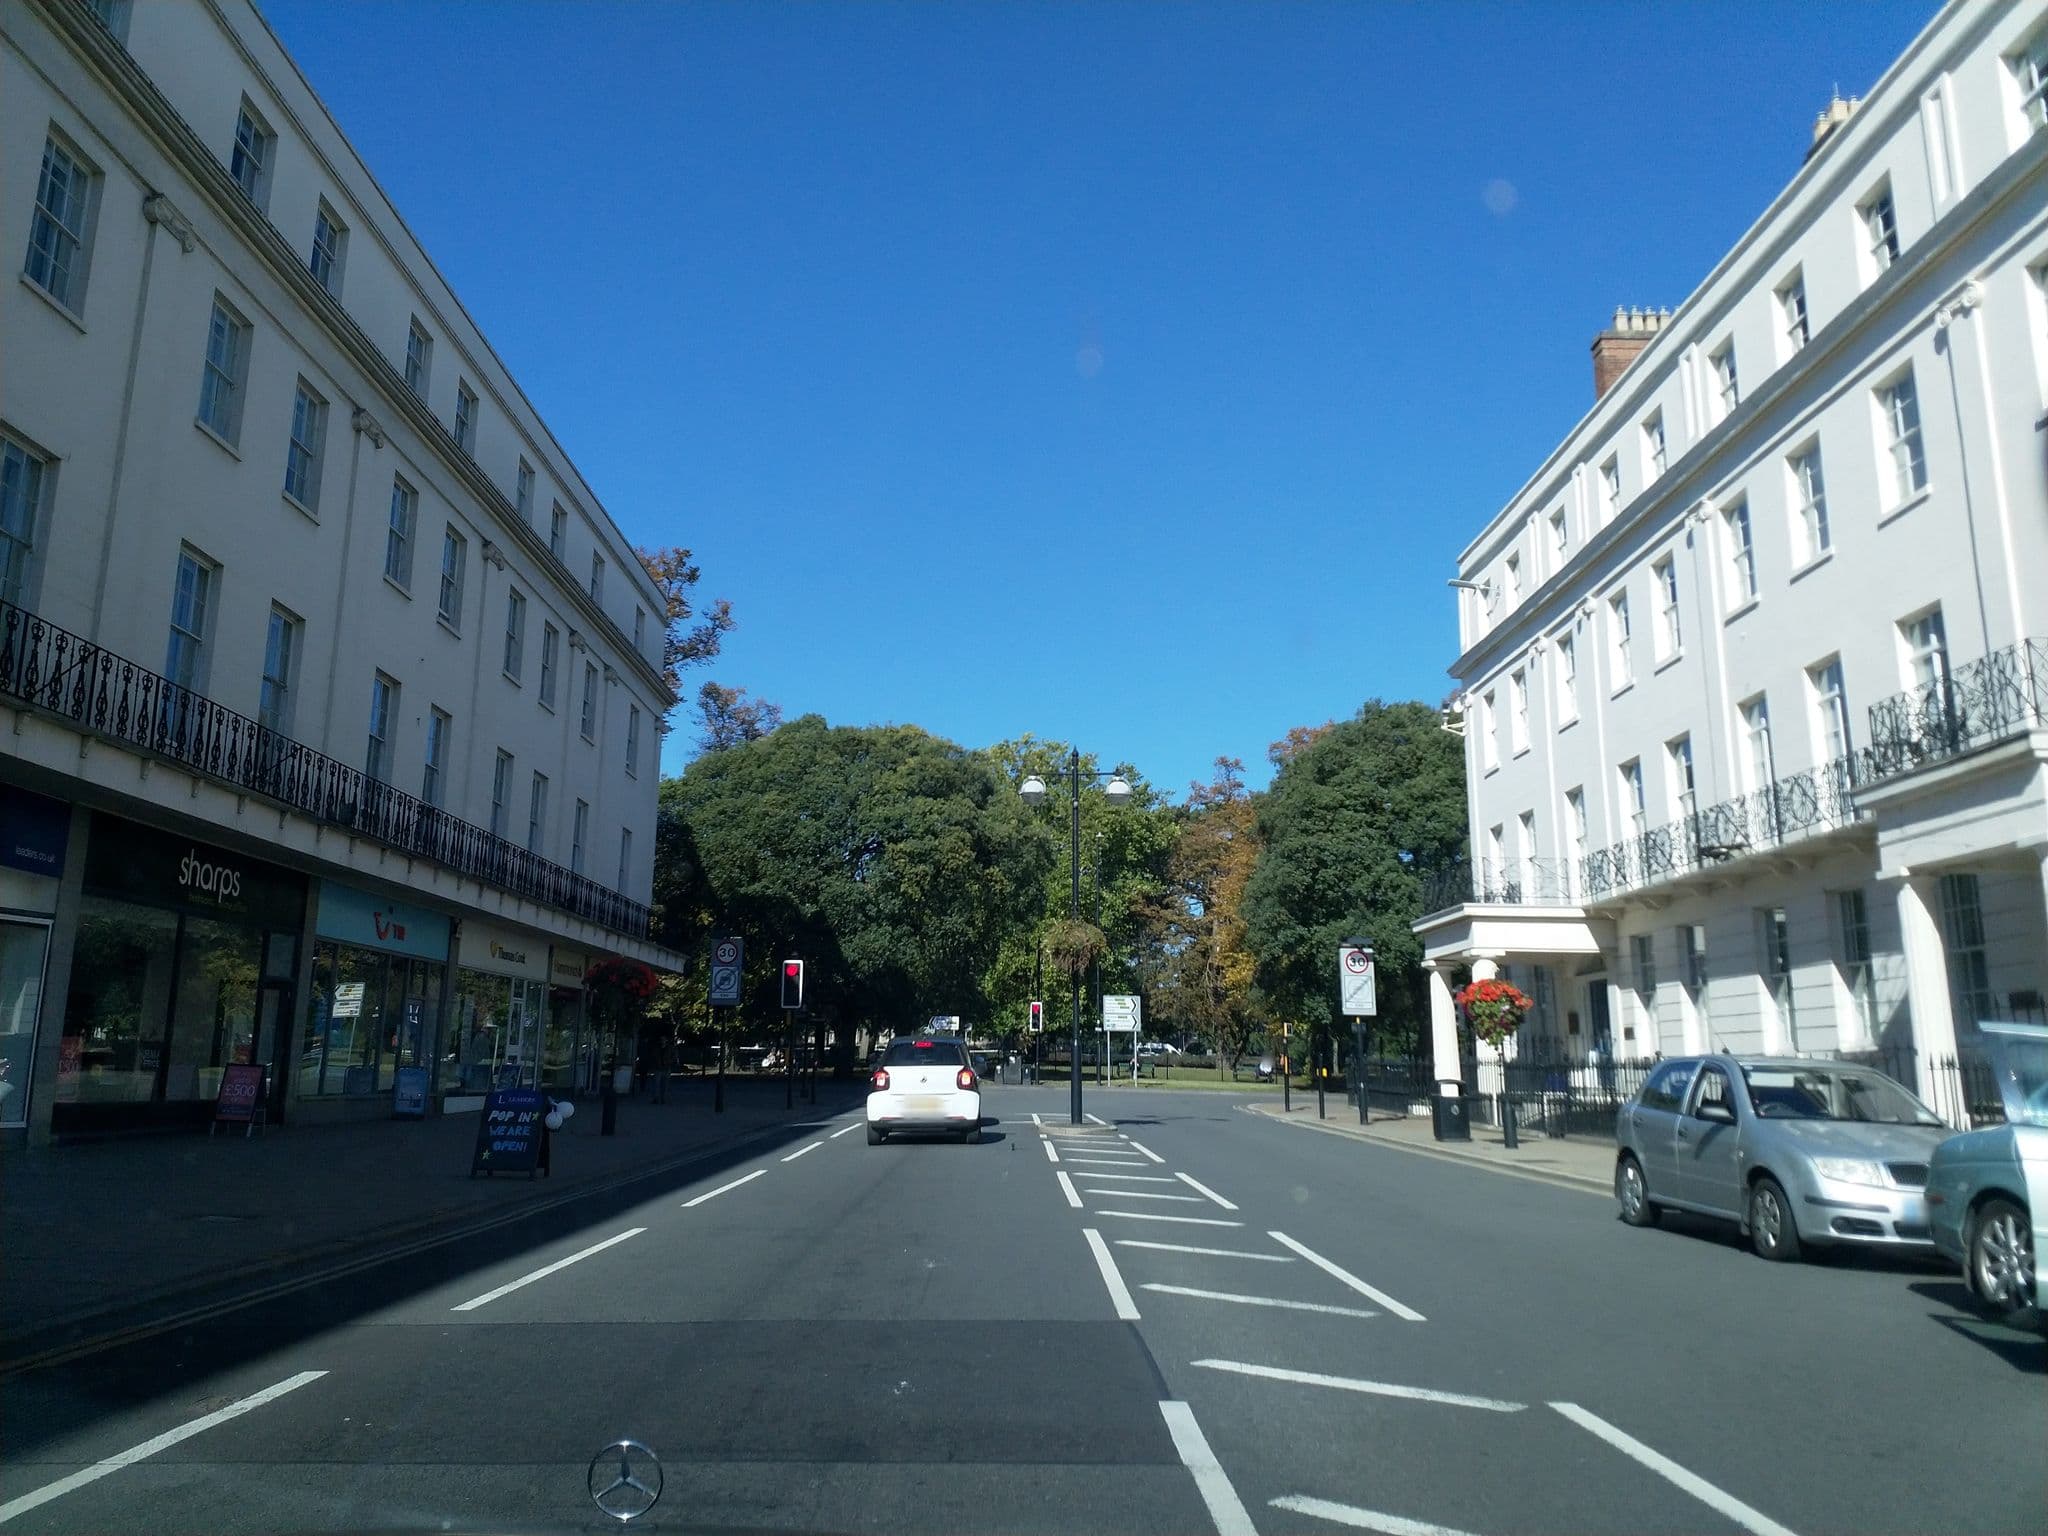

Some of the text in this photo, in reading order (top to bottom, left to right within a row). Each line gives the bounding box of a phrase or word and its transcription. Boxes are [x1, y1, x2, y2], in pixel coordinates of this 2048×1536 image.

[179, 848, 241, 903] sharps
[719, 947, 736, 958] 30
[1349, 957, 1366, 967] 30
[488, 1110, 533, 1124] POP IN
[489, 1126, 531, 1137] WE ARE
